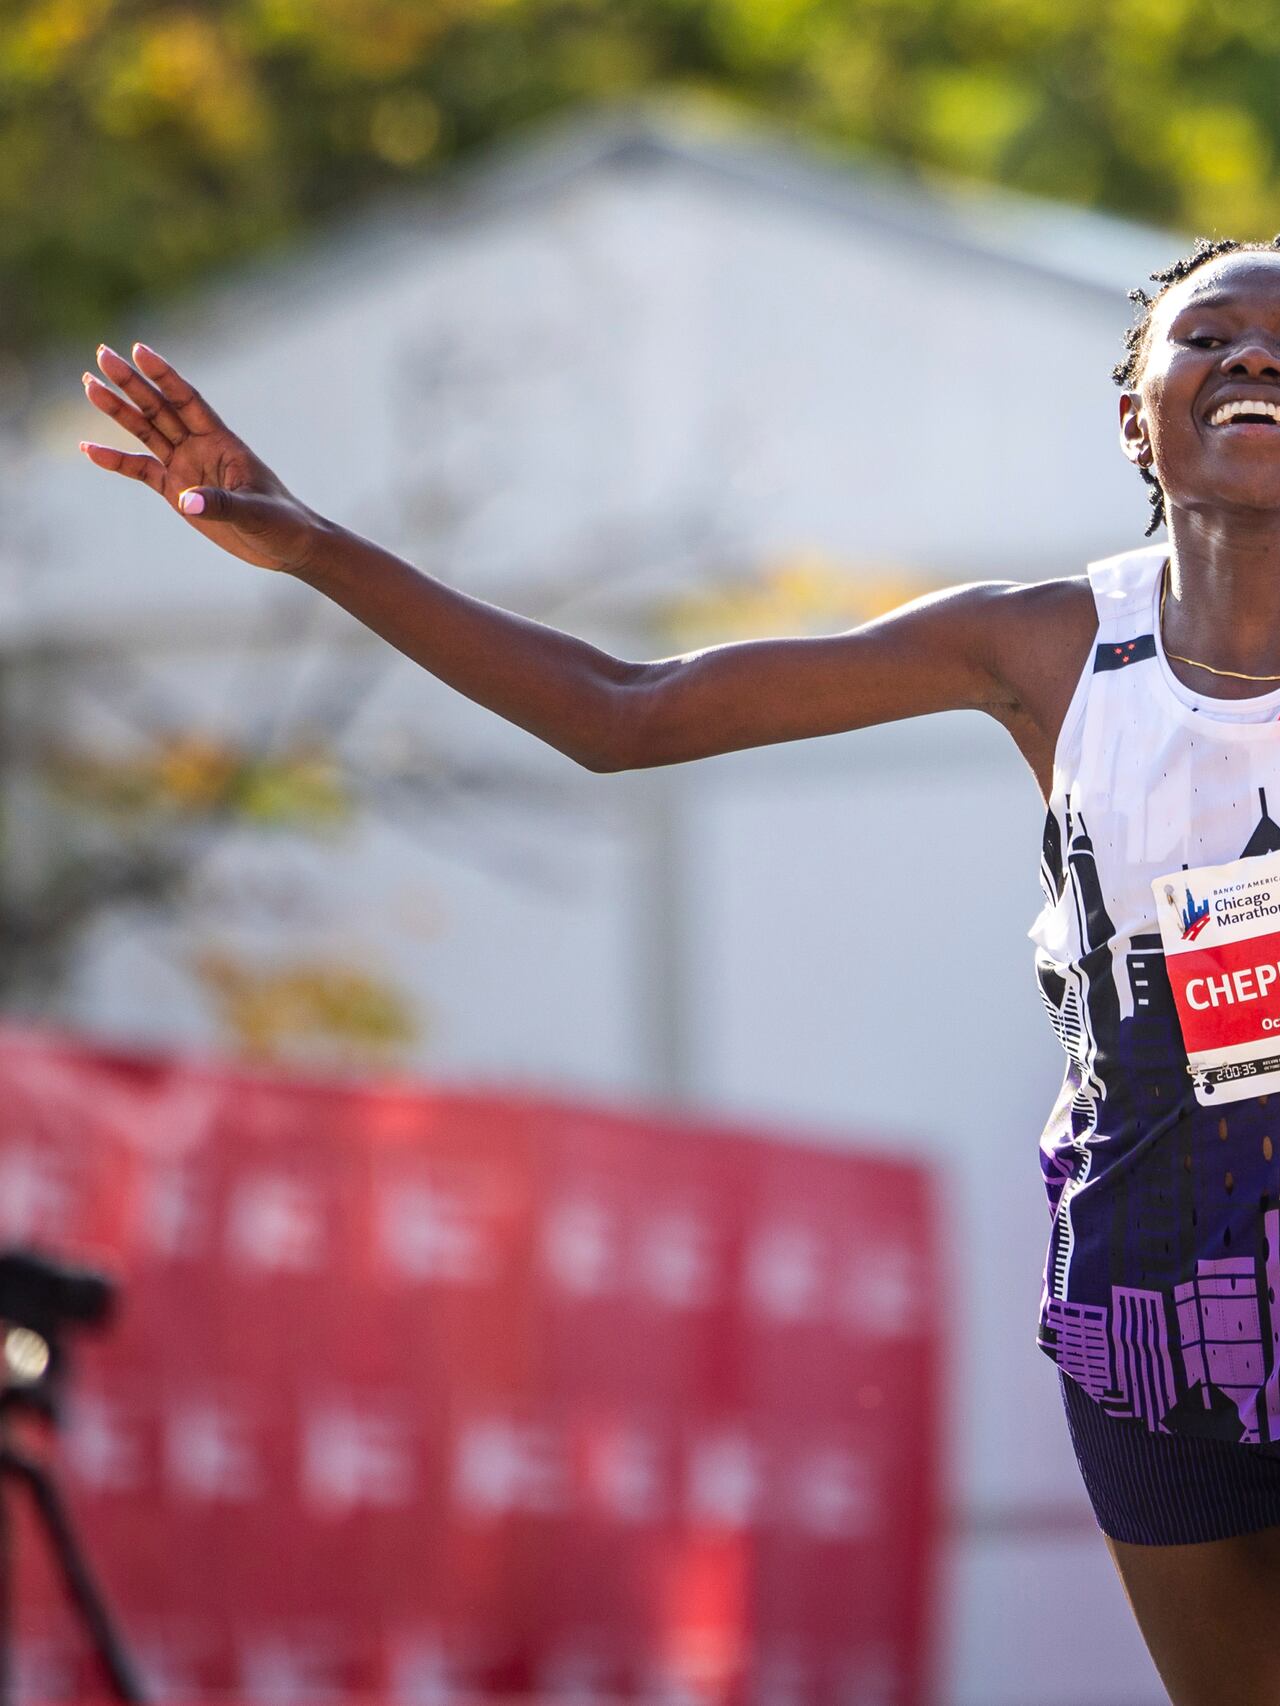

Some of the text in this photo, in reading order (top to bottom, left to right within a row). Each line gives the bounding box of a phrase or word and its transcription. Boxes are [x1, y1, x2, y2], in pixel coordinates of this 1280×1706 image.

[1213, 887, 1234, 895] BANK
[1215, 892, 1271, 912] Chicago
[1217, 1063, 1257, 1081] 2:00:35
